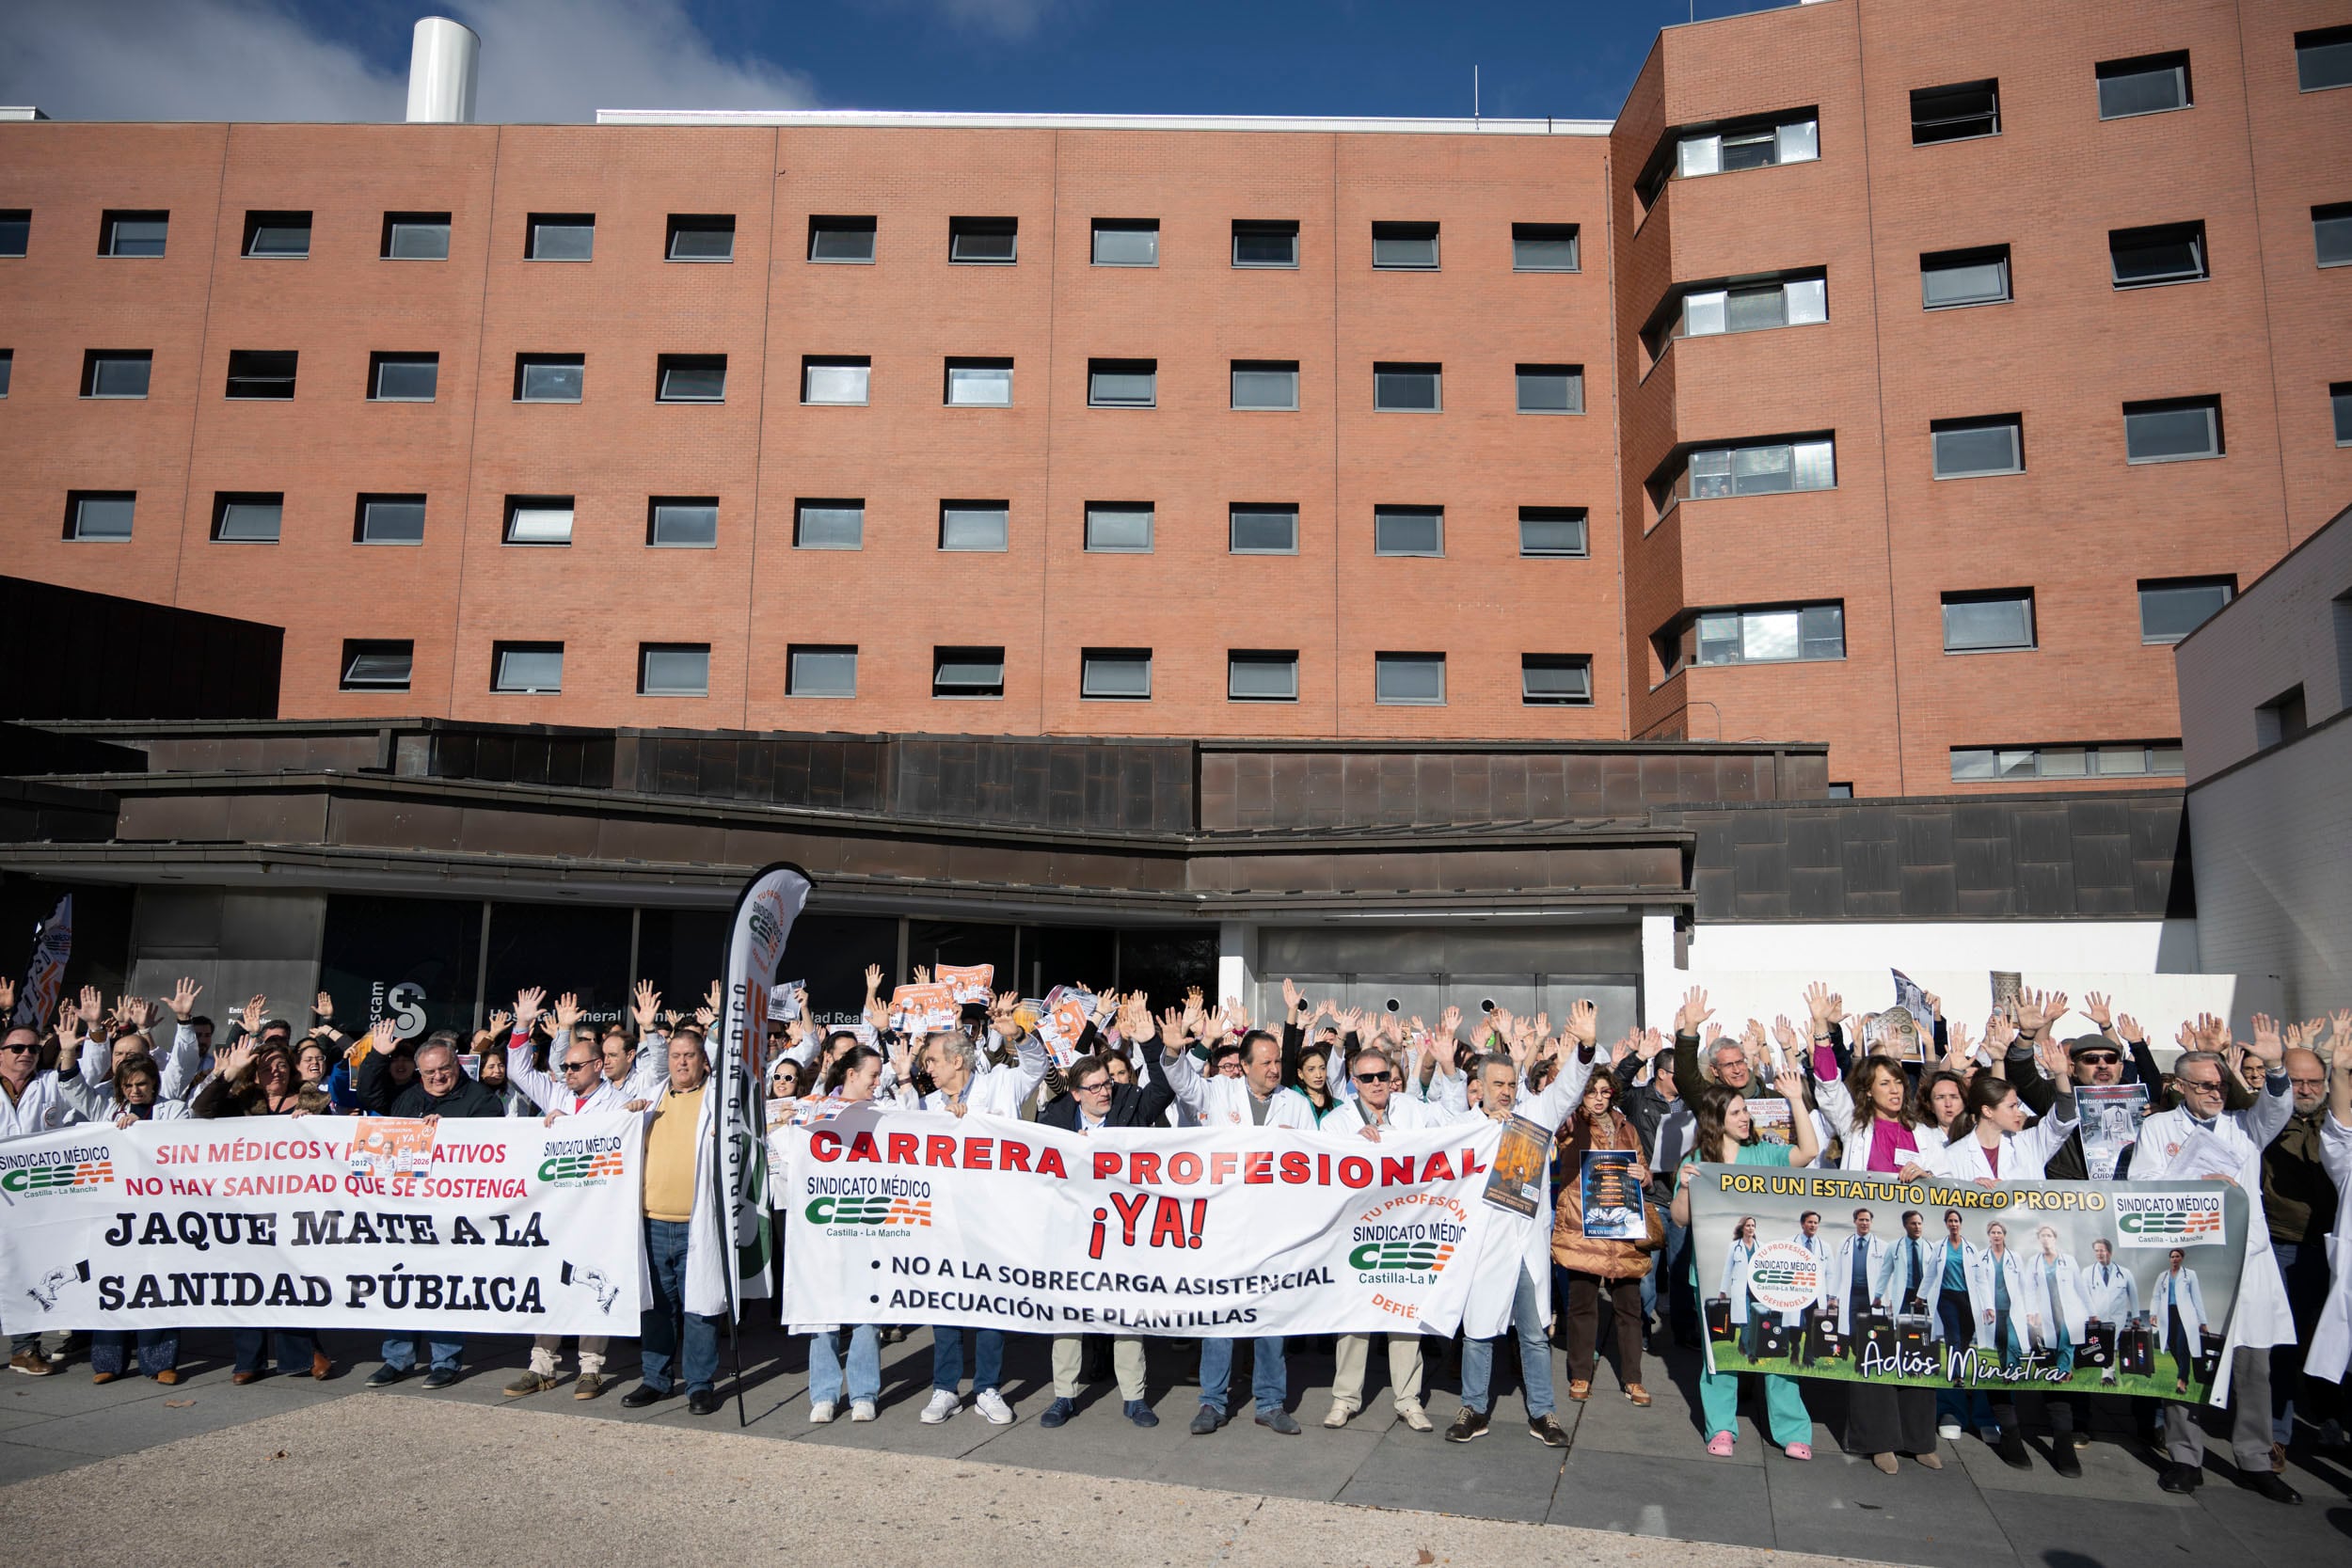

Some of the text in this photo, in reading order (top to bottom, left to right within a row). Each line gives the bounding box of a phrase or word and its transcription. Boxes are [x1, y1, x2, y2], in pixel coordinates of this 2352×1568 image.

[727, 983, 747, 1082] MÉDICO
[0, 1145, 110, 1171] SINDICATO MÉDICO
[156, 1144, 199, 1165] SIN
[208, 1137, 321, 1164] MÉDICOS
[325, 1142, 340, 1160] Y
[544, 1135, 622, 1157] SINDICATO MÉDICO
[809, 1130, 1069, 1180] CARRERA
[1092, 1148, 1487, 1190] PROFESIONAL
[1, 1162, 115, 1193] CESM
[537, 1152, 624, 1181] CESM
[24, 1188, 53, 1198] Castilla
[70, 1185, 98, 1194] Mancha
[125, 1174, 529, 1199] NO HAY SANIDAD QUE SE SOSTENGA
[807, 1174, 930, 1199] SINDICATO MÉDICO
[1720, 1173, 2106, 1212] POR UN ESTATUTO MARCO PROPIO
[804, 1196, 932, 1227] CESM
[1360, 1207, 1382, 1223] TU
[1384, 1193, 1468, 1223] PROFESIÓN
[2117, 1195, 2219, 1212] SINDICATO MÉDICO
[104, 1211, 550, 1251] JAQUE MATE A LA
[826, 1227, 858, 1238] Castilla
[866, 1227, 876, 1237] La
[878, 1228, 911, 1239] Mancha
[1089, 1192, 1208, 1260] ¡YA!
[1353, 1224, 1425, 1243] SINDICATO
[2119, 1212, 2220, 1234] CESM
[2180, 1234, 2203, 1243] Mancha
[1754, 1259, 1817, 1272] SINDICATO MÉDICO
[1757, 1249, 1768, 1259] TU
[98, 1262, 547, 1314] SANIDAD PÚBLICA
[891, 1255, 1335, 1295] NO A LA SOBRECARGA ASISTENCIAL
[1753, 1269, 1817, 1287] CESM
[889, 1289, 1258, 1329] ADECUACIÓN DE PLANTILLAS
[1861, 1340, 2066, 1386] Adiós Ministra
